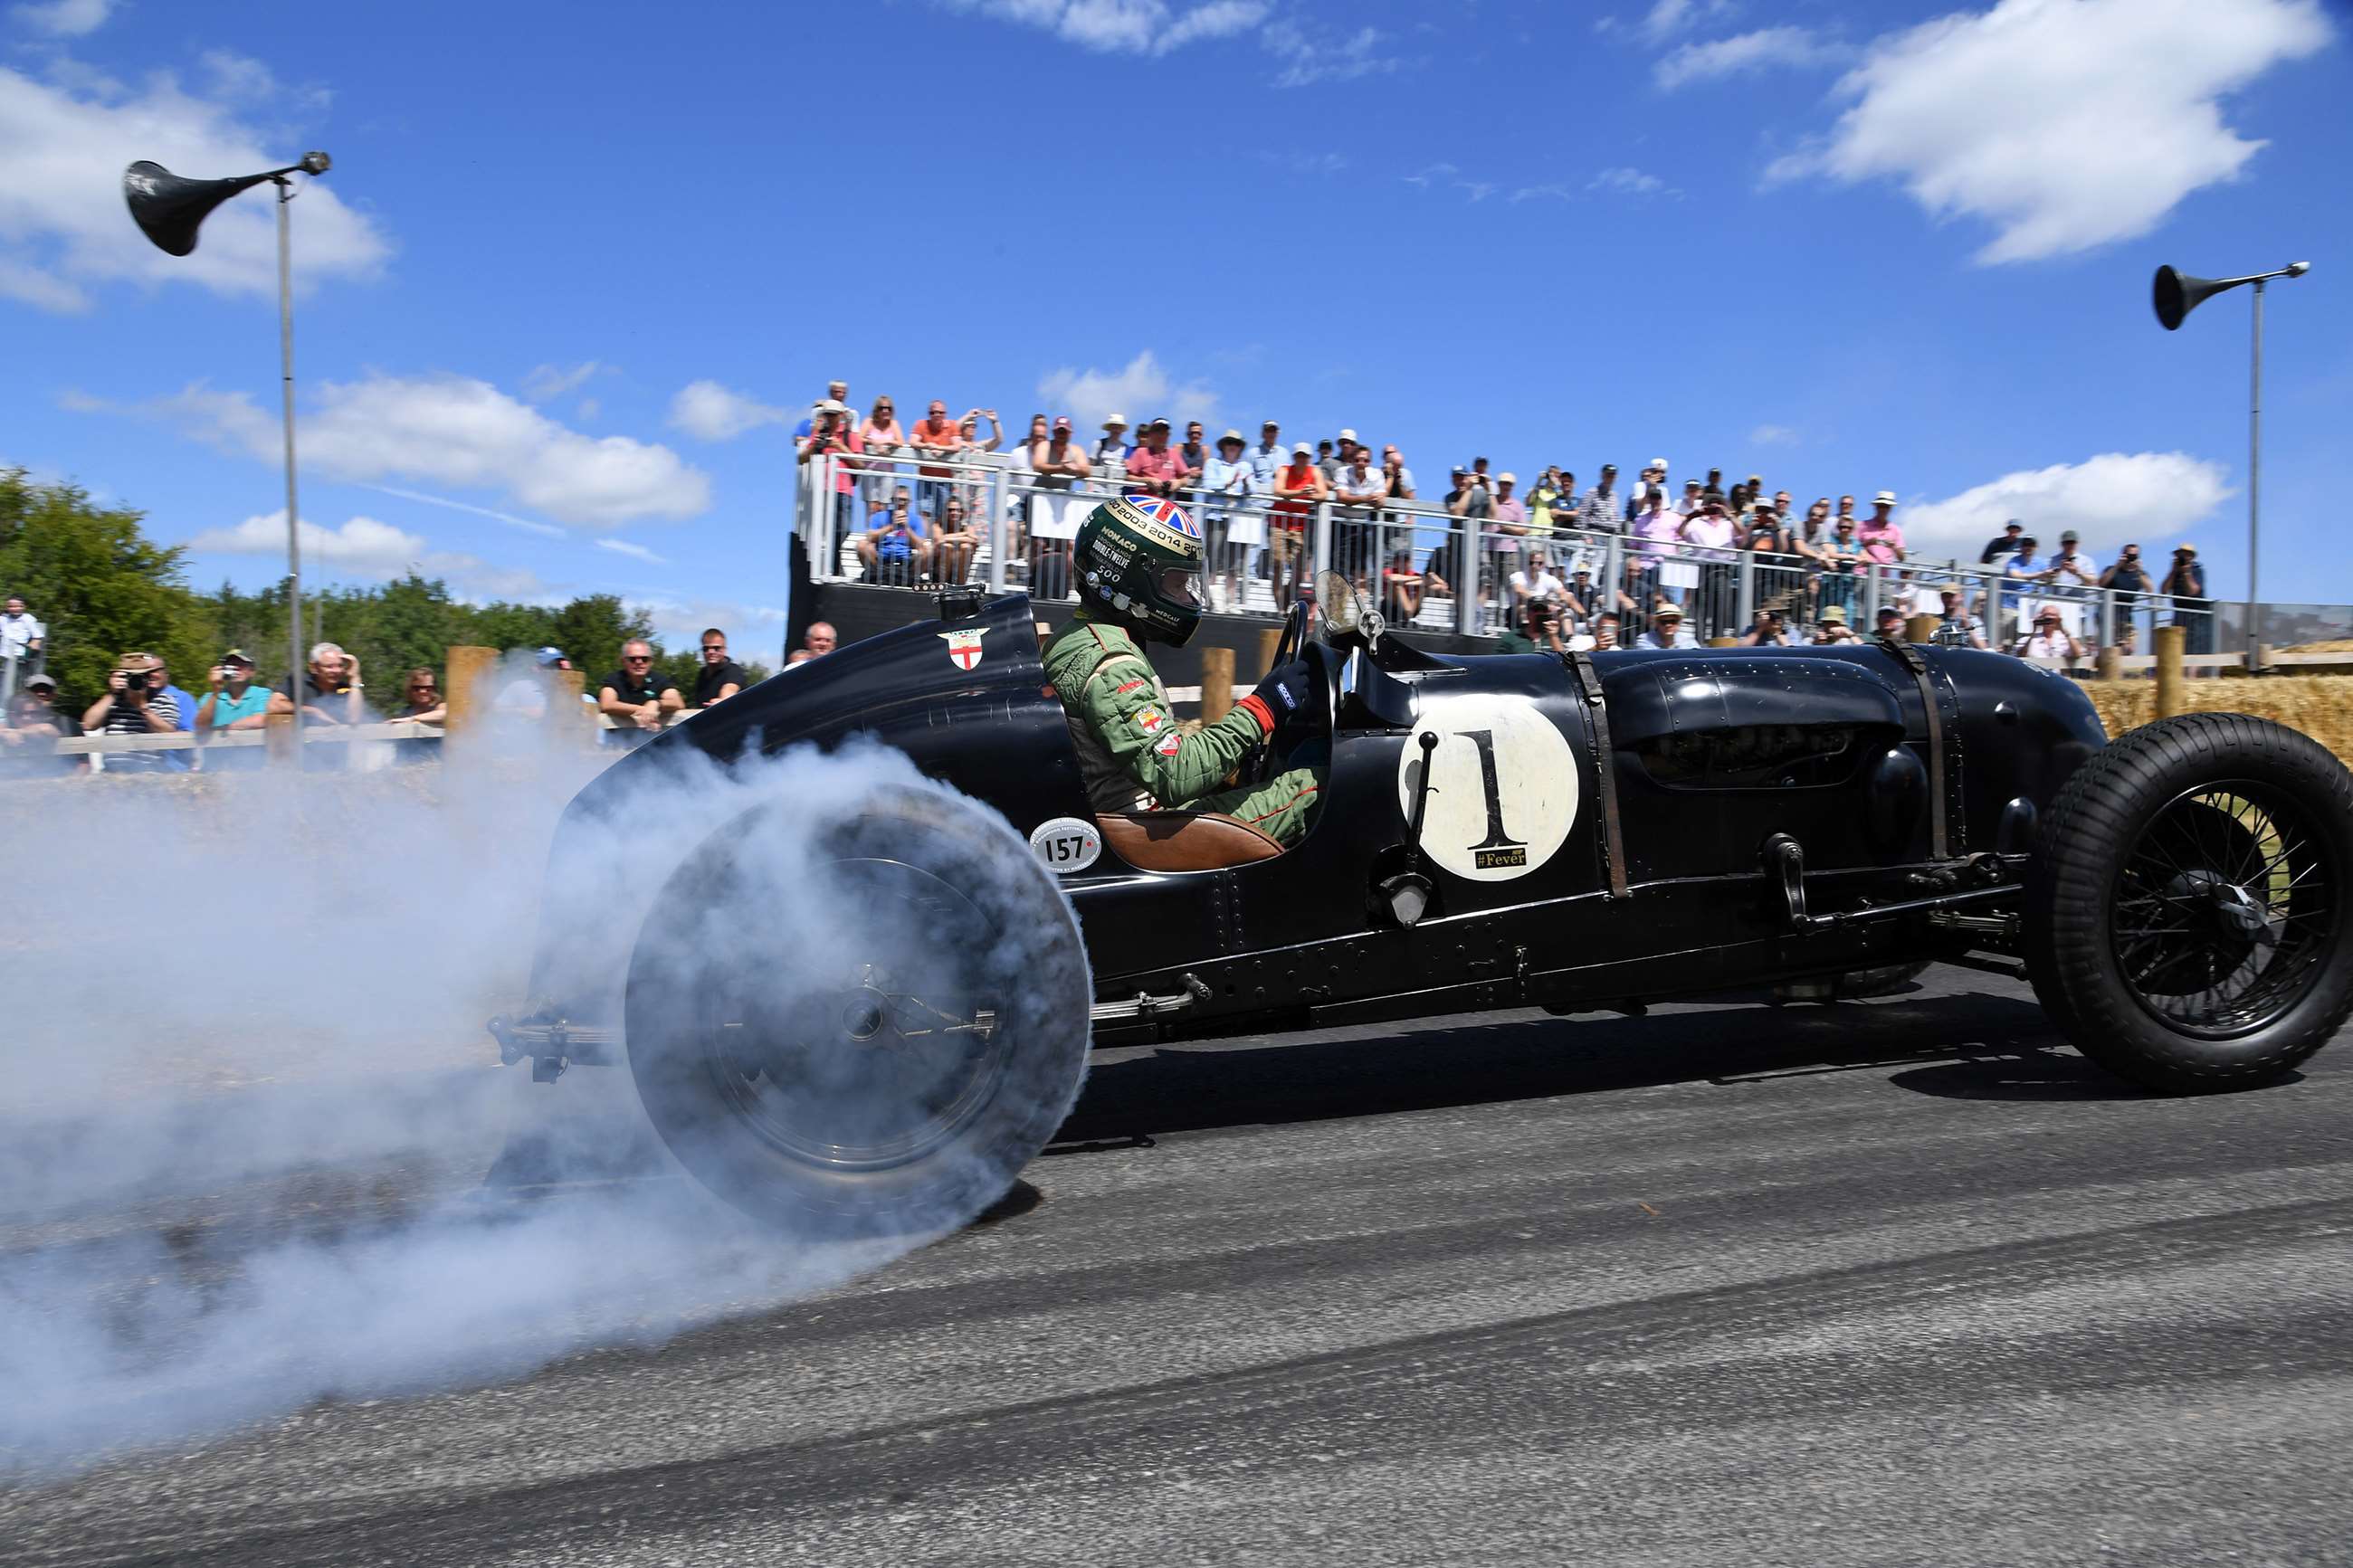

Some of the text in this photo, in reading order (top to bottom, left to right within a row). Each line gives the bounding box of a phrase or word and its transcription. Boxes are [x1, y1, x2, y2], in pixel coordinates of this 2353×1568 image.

[1101, 526, 1137, 552] MONACO
[1117, 507, 1148, 529] 2003
[1148, 527, 1180, 547] 2014
[1097, 565, 1121, 583] 500
[1453, 729, 1529, 851] 1
[1045, 835, 1083, 862] 157
[1477, 853, 1525, 867] #Fever
